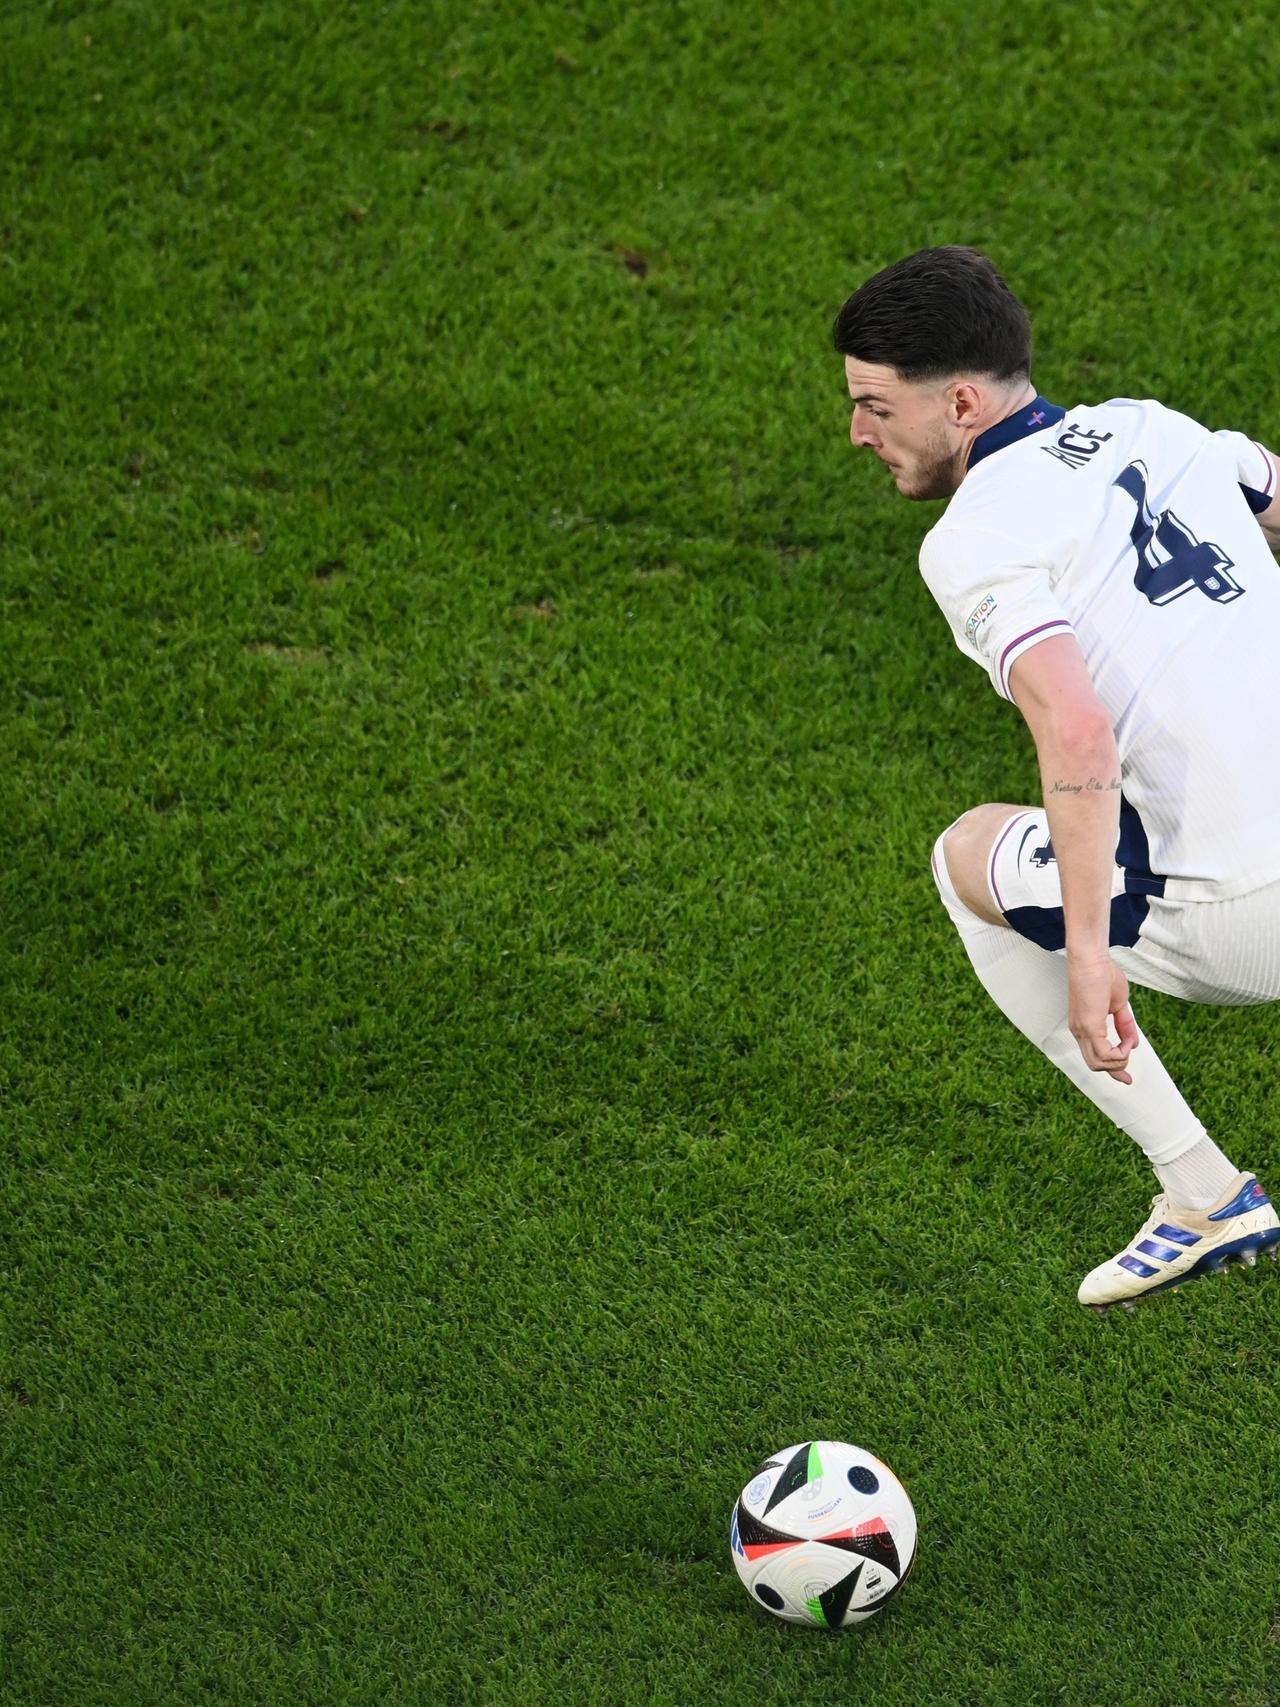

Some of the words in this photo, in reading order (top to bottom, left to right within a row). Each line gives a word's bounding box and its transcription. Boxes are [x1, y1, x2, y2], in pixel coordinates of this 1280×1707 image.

[1040, 423, 1114, 470] RICE
[1112, 459, 1246, 607] 4
[1049, 779, 1083, 794] Nothing
